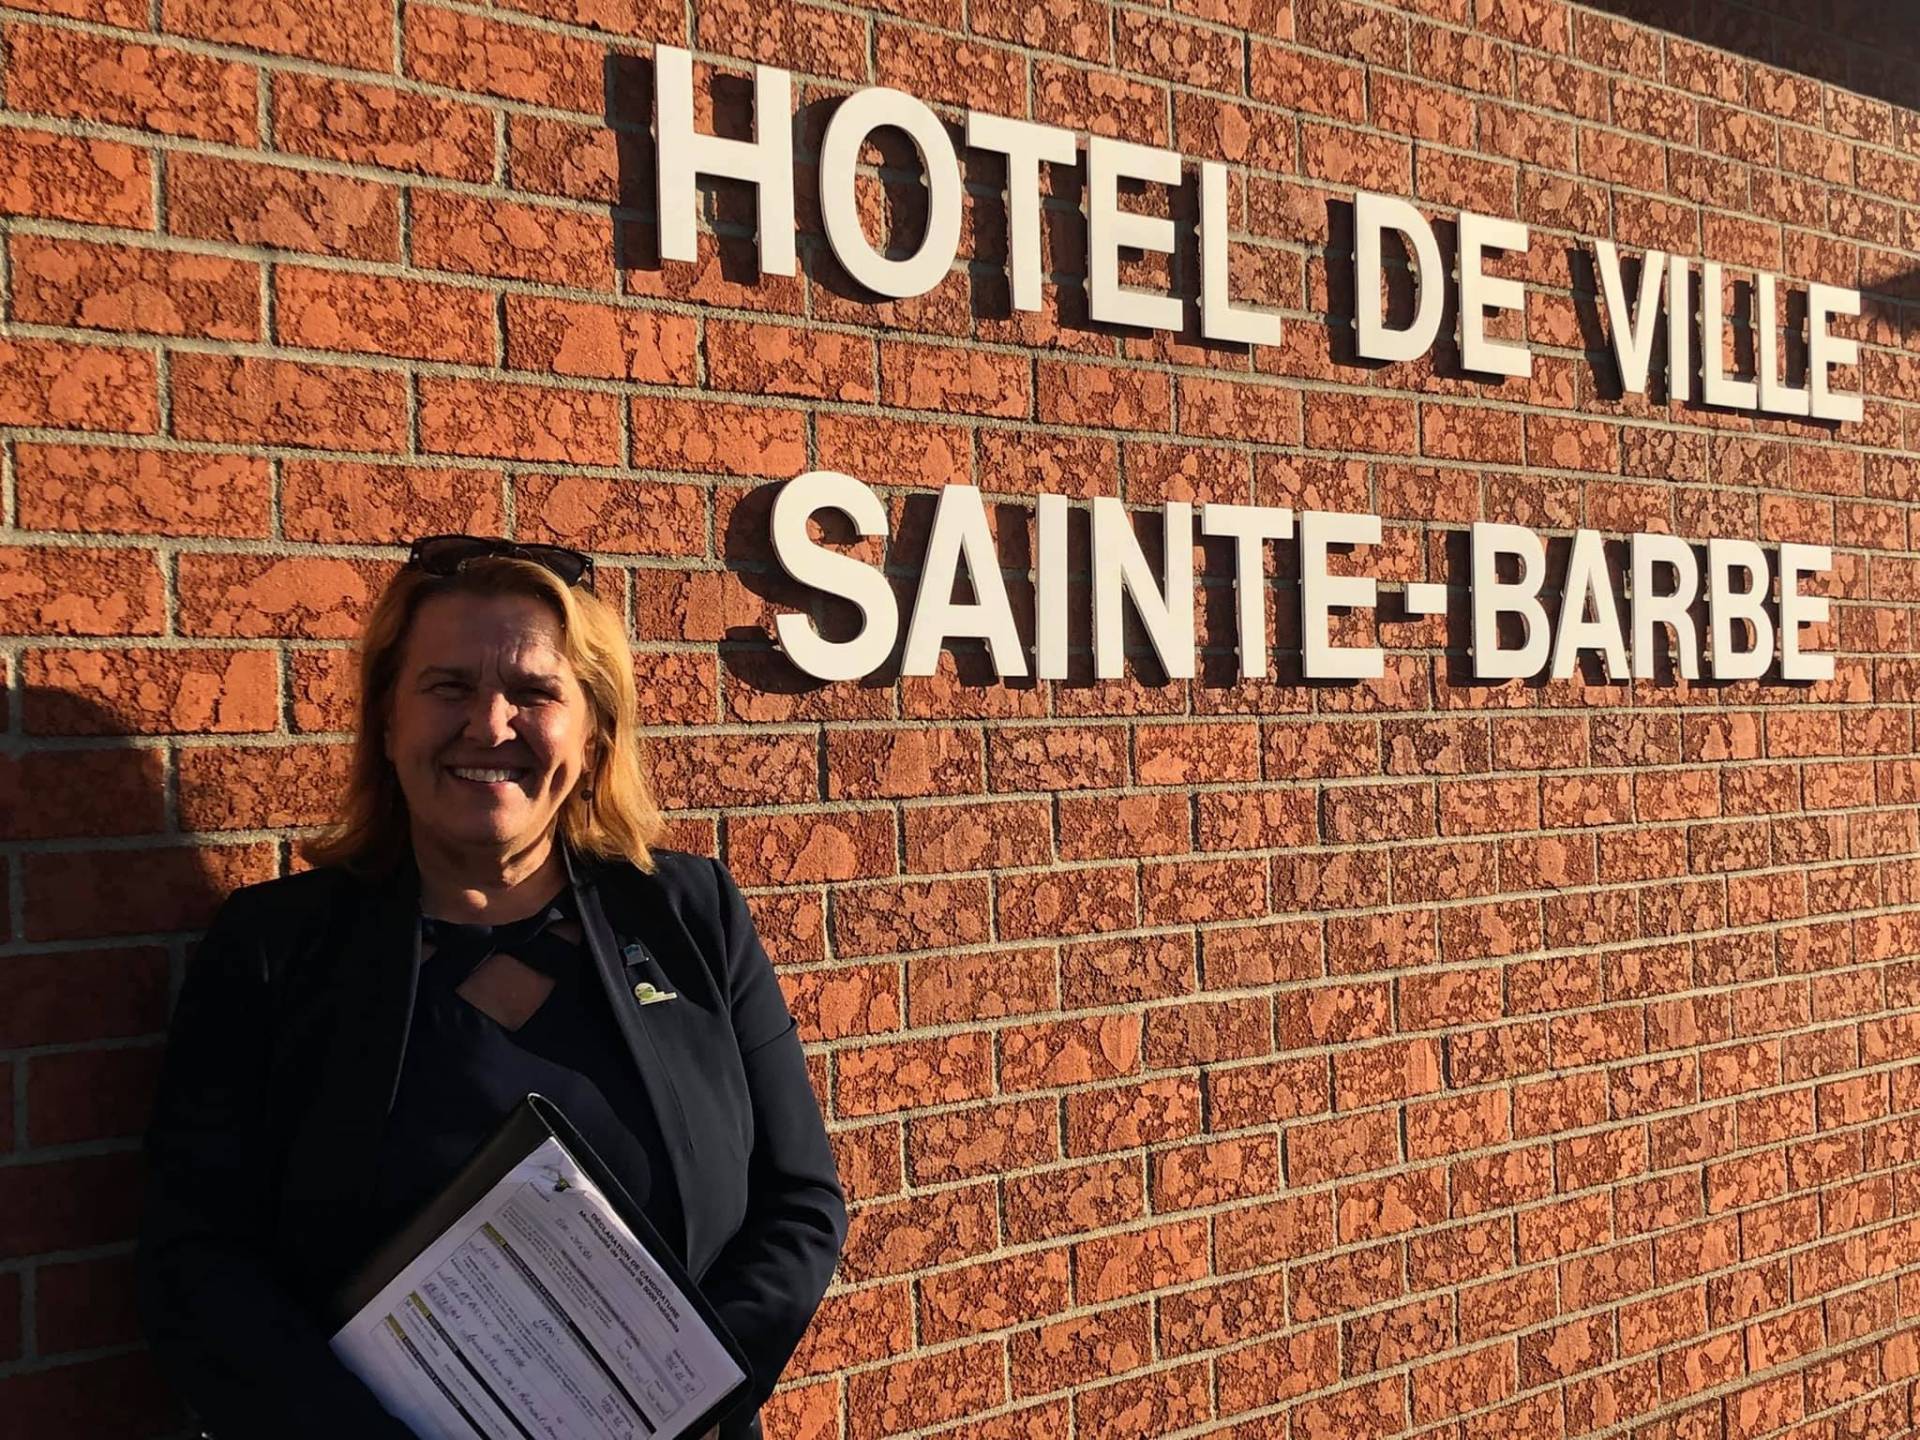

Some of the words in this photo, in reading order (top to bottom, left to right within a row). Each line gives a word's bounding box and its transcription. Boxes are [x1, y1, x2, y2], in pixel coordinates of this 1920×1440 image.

[655, 43, 1282, 347] HOTEL
[1354, 192, 1532, 378] DE
[1594, 239, 1863, 422] VILLE
[770, 471, 1836, 681] SAINTE-BARBE
[590, 1212, 631, 1260] DÉCLARATION
[629, 1259, 640, 1271] DE
[638, 1270, 680, 1319] CANDIDATURE
[609, 1247, 620, 1258] de
